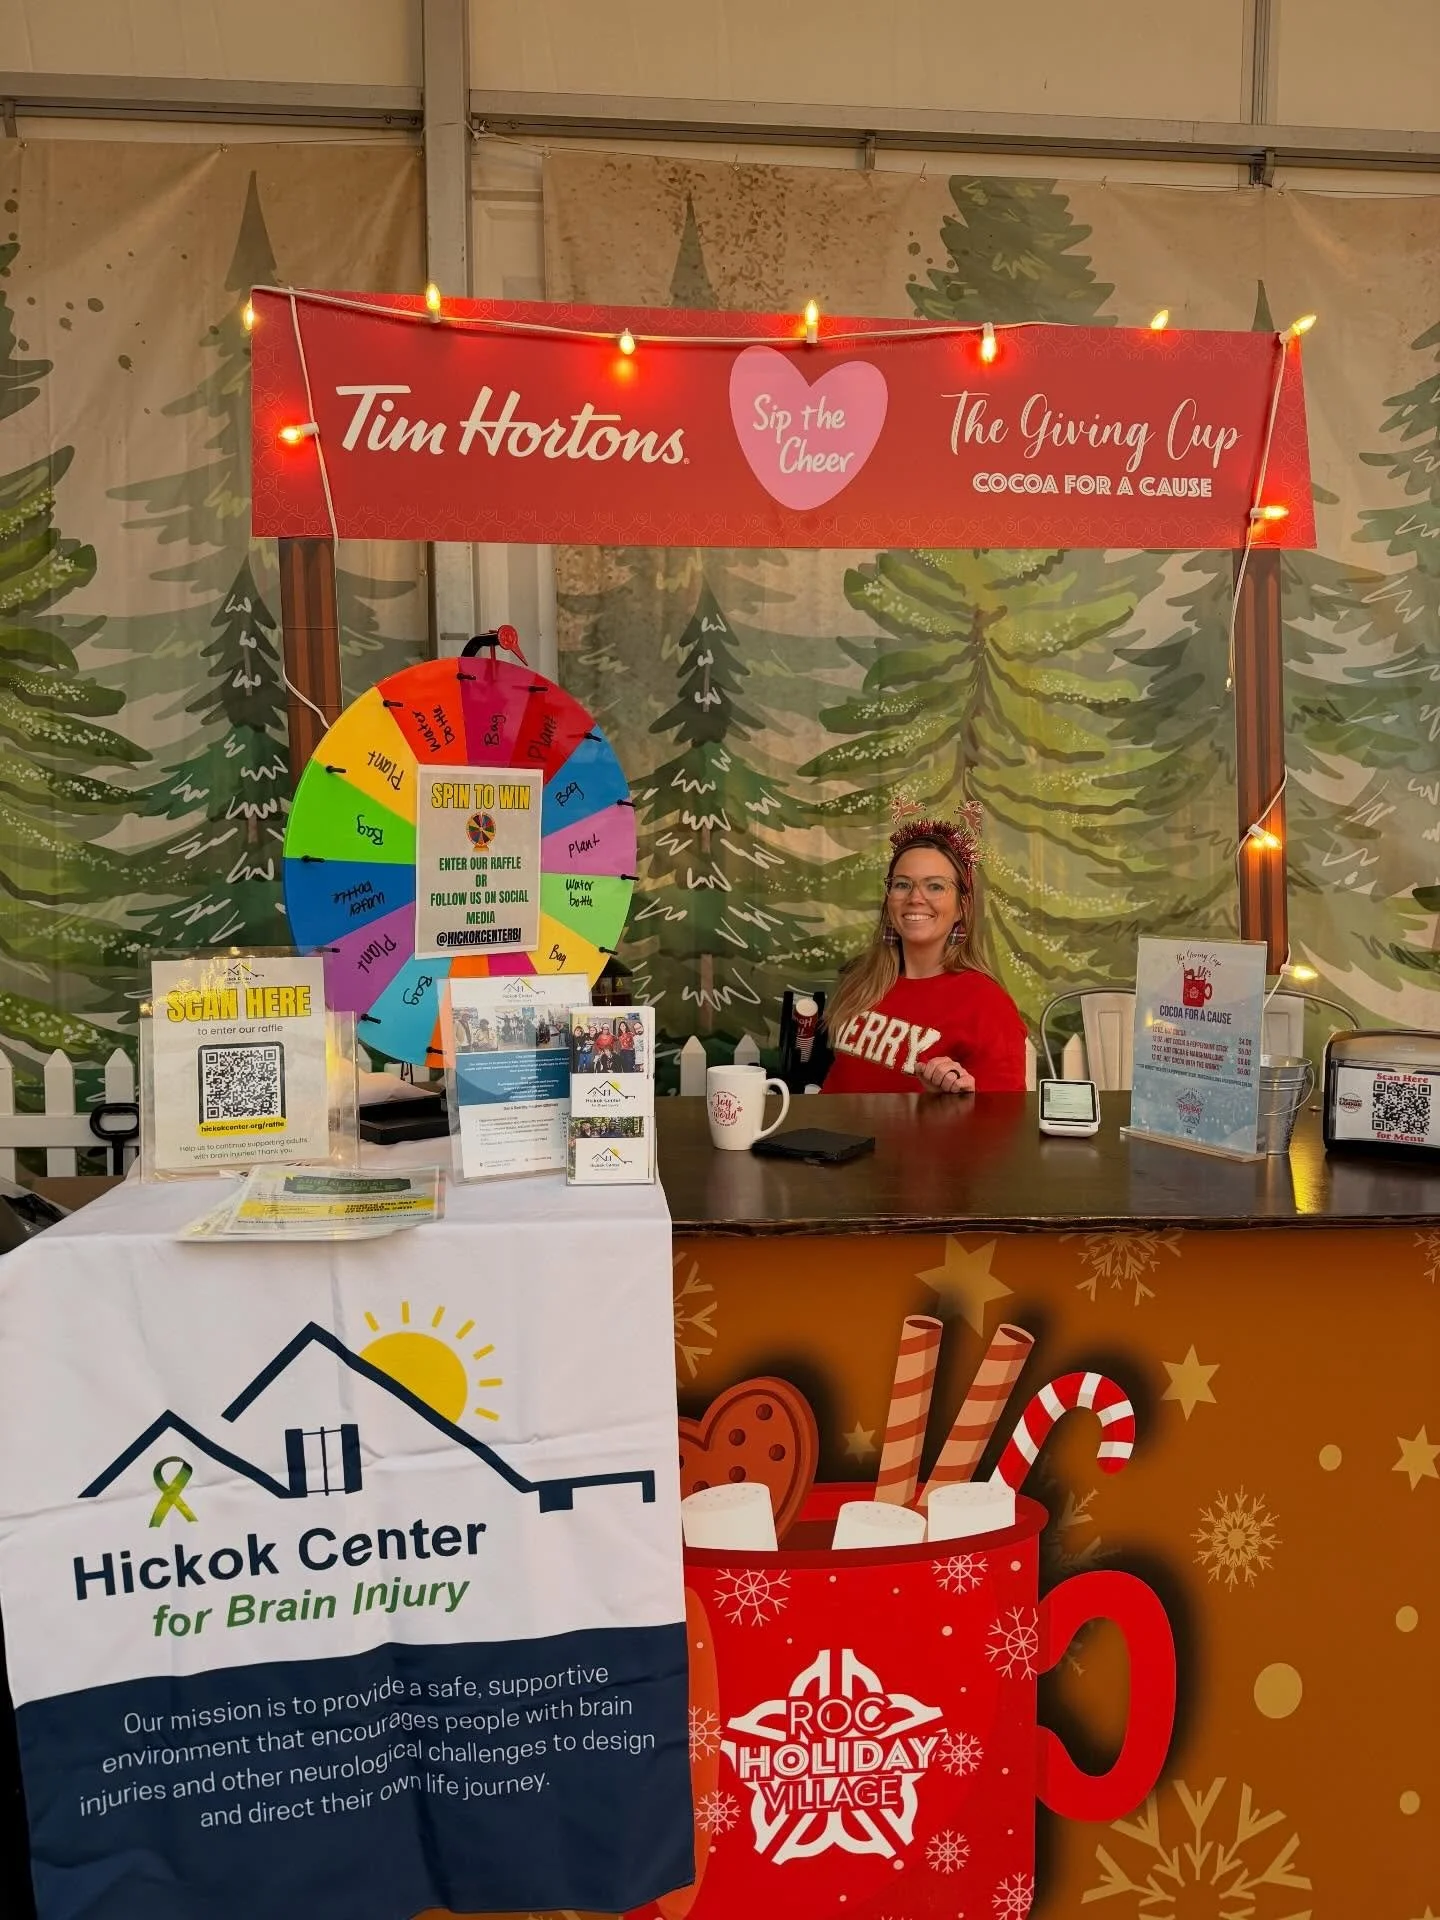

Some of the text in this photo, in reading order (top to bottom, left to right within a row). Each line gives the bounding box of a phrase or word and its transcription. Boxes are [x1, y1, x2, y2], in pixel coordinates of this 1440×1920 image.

[335, 385, 685, 464] Tim Hortons
[752, 394, 846, 444] Sip the
[941, 390, 1244, 473] The Giving Cup
[780, 436, 855, 473] Cheer
[972, 472, 1212, 498] COCOA FOR A CAUSE
[484, 714, 506, 745] Bag
[368, 750, 404, 791] Plant
[431, 783, 530, 810] SPIN TO WIN
[555, 782, 584, 807] Bag
[356, 814, 384, 846] Bag
[439, 856, 522, 871] ENTER OUR RAFFLE
[475, 874, 488, 887] OR
[430, 889, 529, 907] FOLLOW US ON SOCIAL
[466, 910, 495, 925] MEDIA
[436, 927, 522, 946] @HICKOKCENTERBI
[357, 933, 397, 974] Plant
[549, 944, 567, 971] Bag
[167, 985, 312, 1022] SCAN HERE
[403, 976, 432, 1005] Bag
[198, 1024, 283, 1036] to enter our raffle
[1160, 1005, 1233, 1025] COCOA FOR A CAUSE
[1376, 1073, 1429, 1084] Scan Here
[201, 1120, 285, 1133] hickokcenter.org/raffle
[1394, 1133, 1425, 1143] Menu
[73, 1519, 487, 1600] Hickok Center
[153, 1577, 470, 1637] for Brain Injury
[124, 1664, 609, 1735] Our mission is to provide a safe, supportive
[790, 1698, 887, 1735] ROC
[102, 1695, 633, 1774] environment that encourages people with brain
[80, 1729, 656, 1817] injuries and other neurological challenges to design
[739, 1736, 939, 1779] HOLIDAY
[200, 1772, 550, 1828] and direct their own life journey.
[760, 1777, 899, 1812] VILLAGE
